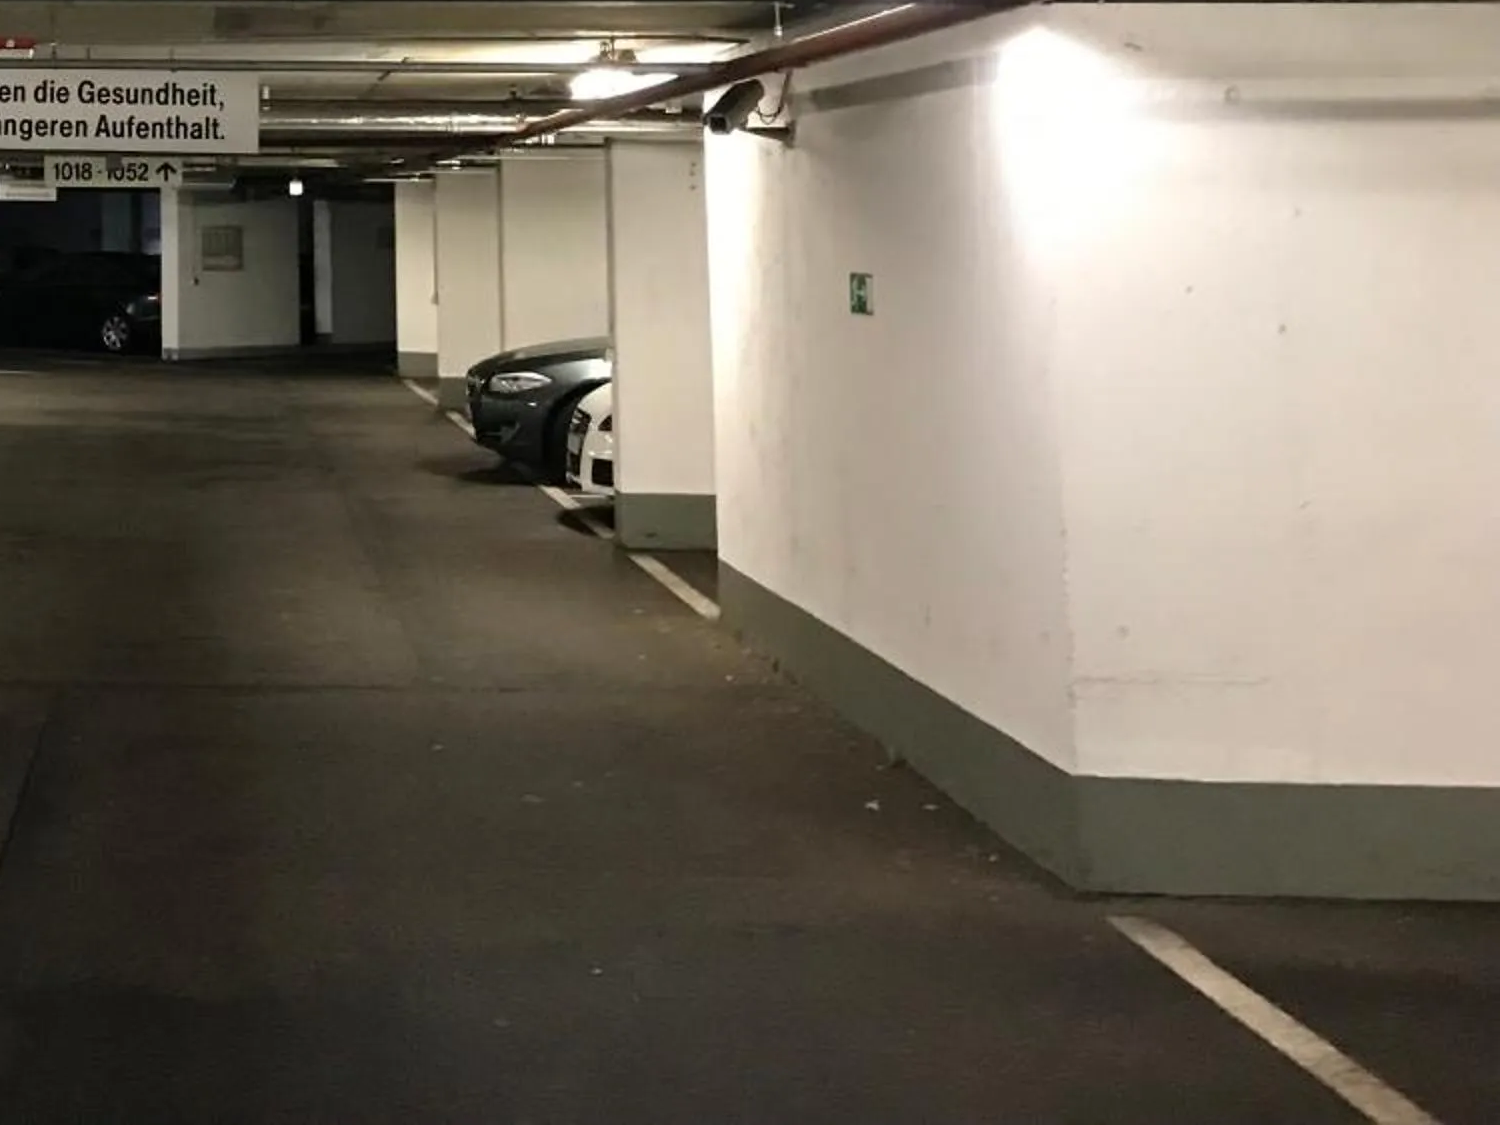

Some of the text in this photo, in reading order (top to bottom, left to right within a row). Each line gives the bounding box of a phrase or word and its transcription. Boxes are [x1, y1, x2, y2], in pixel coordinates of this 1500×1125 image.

[33, 79, 70, 104] die
[77, 80, 225, 110] Gesundheit,
[95, 114, 225, 140] Aufenthalt.
[54, 162, 93, 181] 1018
